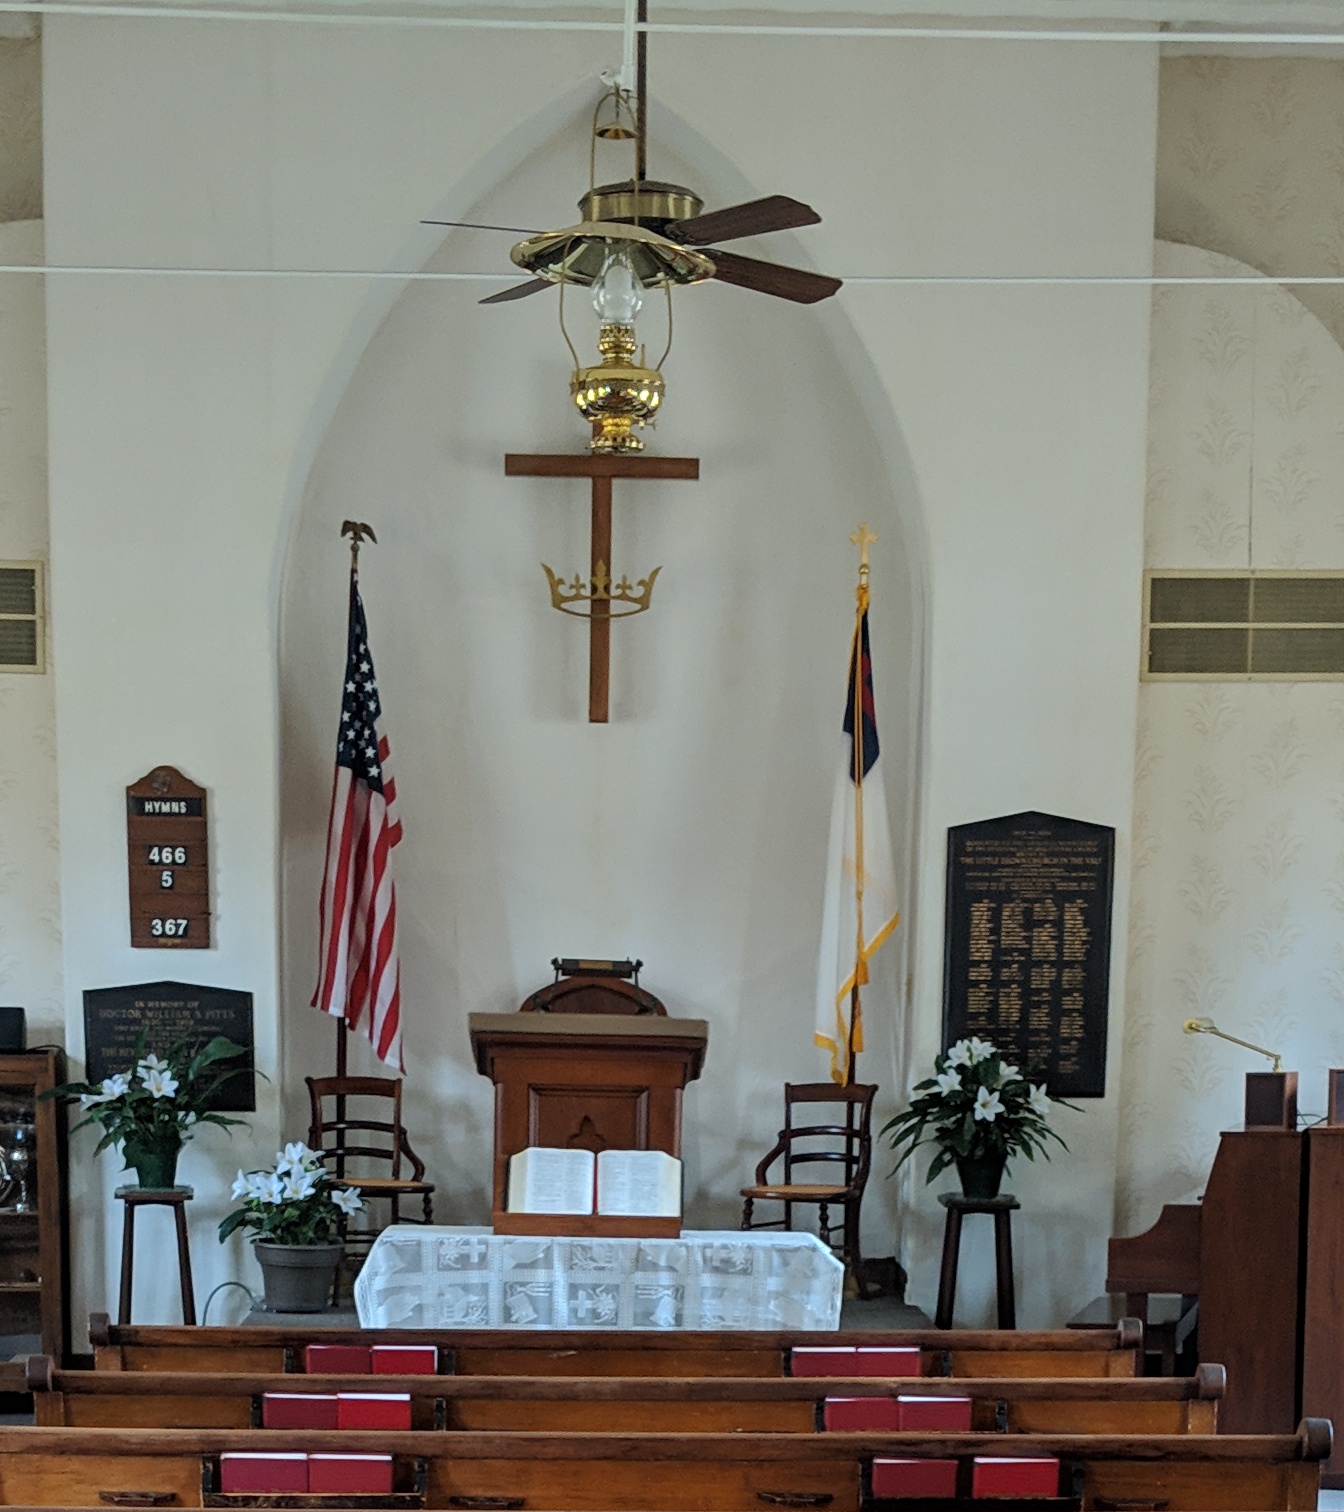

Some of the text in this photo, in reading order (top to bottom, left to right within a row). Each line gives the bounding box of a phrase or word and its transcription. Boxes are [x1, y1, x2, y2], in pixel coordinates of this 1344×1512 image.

[145, 800, 187, 813] HYMNS
[149, 847, 186, 864] 466
[161, 870, 173, 888] 5
[151, 918, 188, 936] 367
